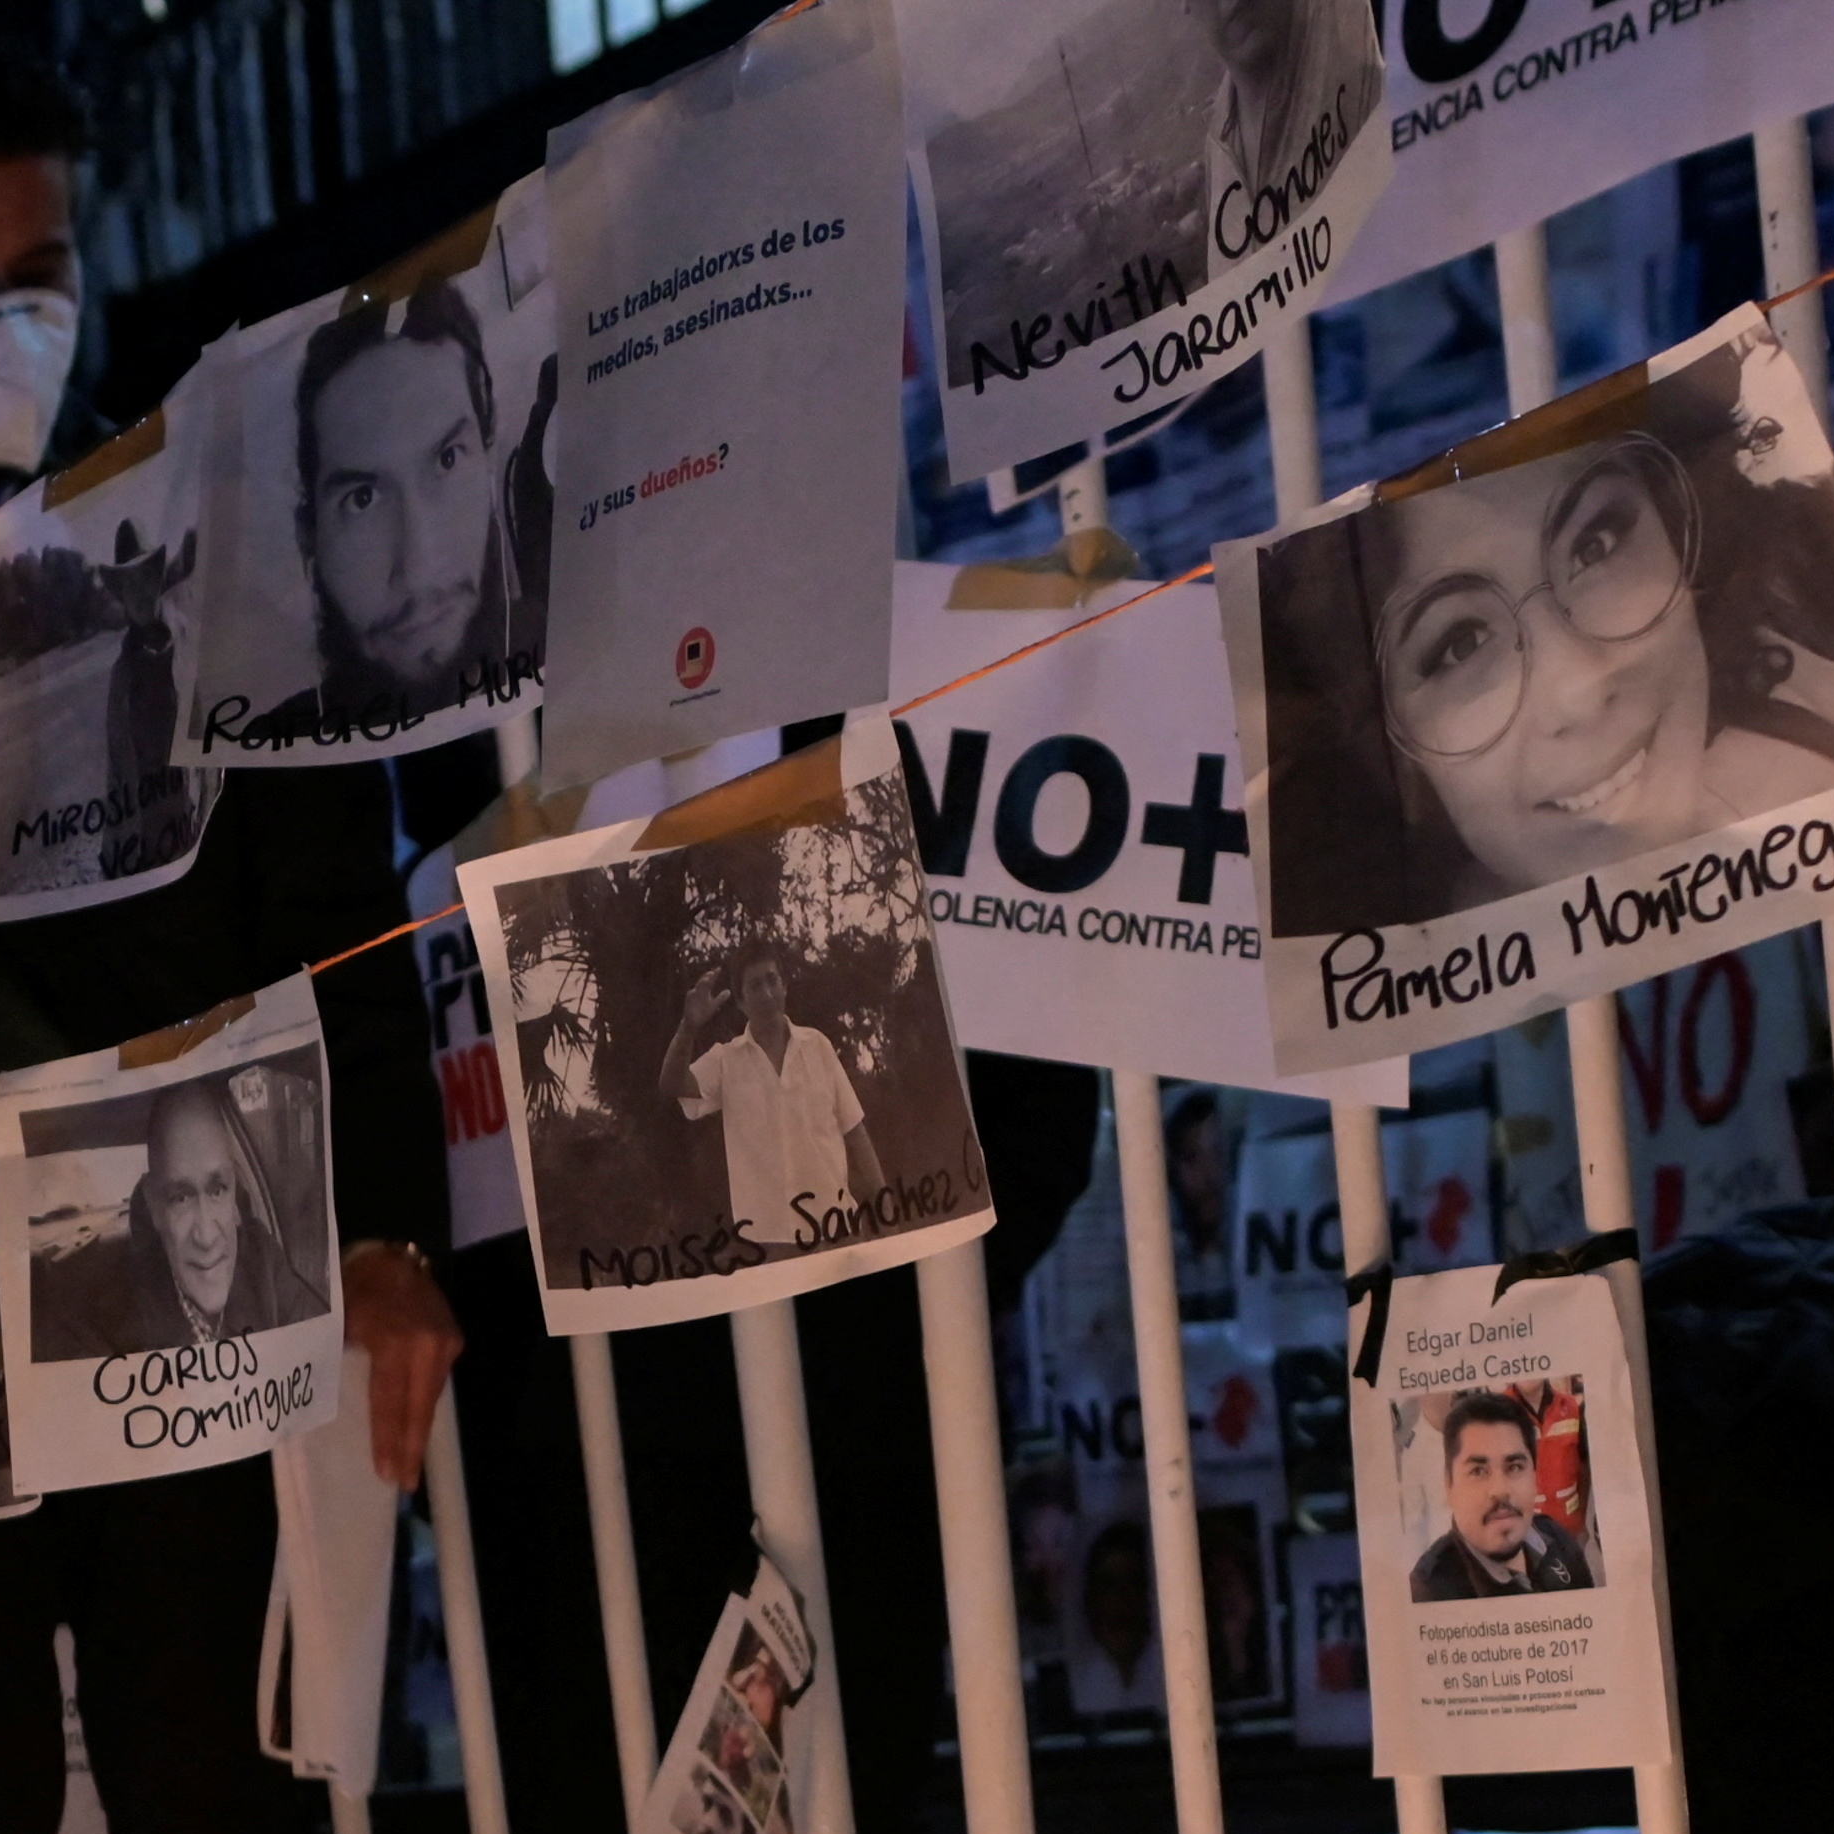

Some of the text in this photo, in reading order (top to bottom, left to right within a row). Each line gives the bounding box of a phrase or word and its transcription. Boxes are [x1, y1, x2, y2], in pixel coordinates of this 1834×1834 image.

[1492, 12, 1639, 101] CONTRA
[1648, 0, 1727, 34] PE
[587, 216, 846, 337] Lxs trabajadorxs de los
[970, 83, 1348, 396] Nevith Condes
[586, 280, 814, 385] medios, asesinadxs...
[579, 441, 730, 532] ¿y sus dueños?
[926, 886, 1262, 960] OLENCIA CONTRA PE
[1320, 926, 1538, 1029] Pamela
[791, 1167, 957, 1253] Sánchez
[1399, 1354, 1551, 1391] Esqueda Castro
[1407, 1313, 1533, 1356] Edgar Daniel
[1419, 1613, 1594, 1643] Fotoperiodista asesinado
[1427, 1638, 1590, 1666] el 6 de octubre de 2017
[1443, 1663, 1575, 1690] en San Luis Potosí
